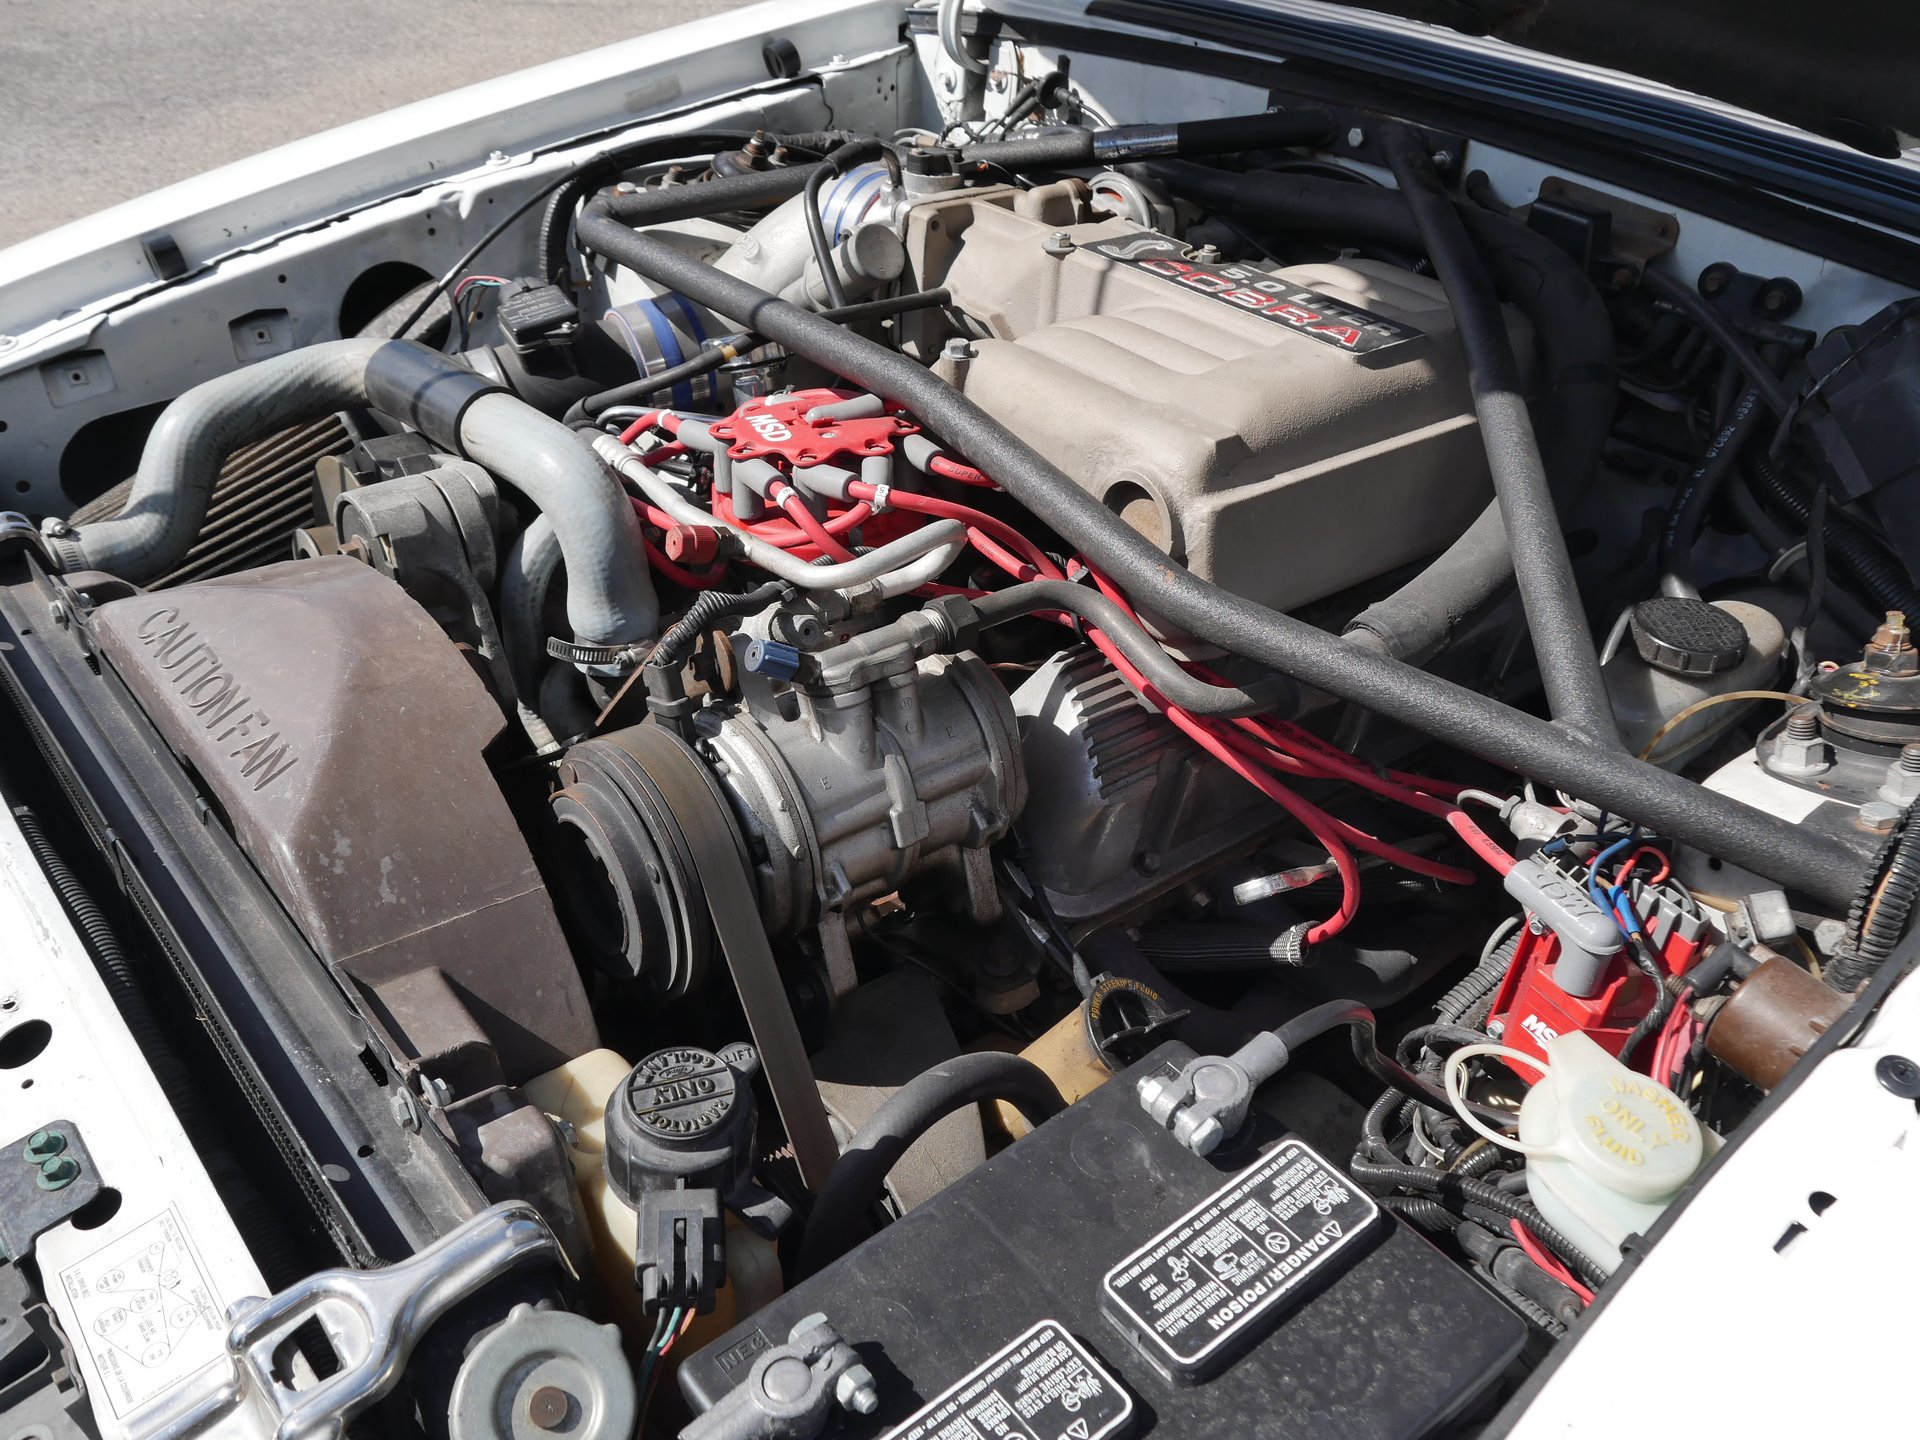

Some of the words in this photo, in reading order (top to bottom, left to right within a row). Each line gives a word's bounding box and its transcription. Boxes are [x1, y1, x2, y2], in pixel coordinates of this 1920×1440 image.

[1138, 257, 1364, 348] COBRA
[1220, 267, 1287, 292] 5.0
[1286, 292, 1401, 338] LITER
[745, 414, 793, 443] MSD
[947, 464, 983, 481] SUPER
[137, 606, 250, 729] CAUTION
[216, 708, 299, 792] FAN
[1091, 993, 1102, 1019] POWER
[1100, 979, 1133, 993] STEERING
[1135, 980, 1159, 1000] FLUID
[1521, 1013, 1560, 1048] MS
[723, 1047, 753, 1065] LIFT
[636, 1050, 716, 1084] COOLANT
[652, 1077, 716, 1106] ONLY
[646, 1099, 730, 1133] RADIATOR
[1610, 1076, 1691, 1143] WASHER
[1601, 1095, 1669, 1150] ONLY
[1585, 1114, 1646, 1167] FLUID
[1274, 1155, 1289, 1166] OUT
[1283, 1146, 1300, 1160] KEEP
[1260, 1166, 1274, 1177] THE
[1268, 1161, 1280, 1171] OF
[1239, 1183, 1251, 1193] OF
[1245, 1172, 1266, 1189] REACH
[1286, 1170, 1307, 1187] CAUSE
[1290, 1169, 1328, 1199] EXPLOSIVE
[1217, 1188, 1244, 1210] CHILDREN
[1294, 1187, 1320, 1208] SHIELD
[1227, 1199, 1256, 1222] SMOKING
[1278, 1204, 1299, 1221] EYES
[1175, 1226, 1193, 1241] KEEP
[1190, 1219, 1204, 1230] TIP
[1255, 1222, 1270, 1235] NO
[1185, 1233, 1209, 1253] INJURY
[1209, 1239, 1231, 1257] CAUSE
[1227, 1231, 1242, 1244] CAN
[1136, 1254, 1156, 1270] TIGHT
[1238, 1249, 1259, 1266] ACID
[1267, 1231, 1330, 1283] DANGER
[1126, 1264, 1143, 1278] AND
[1229, 1256, 1266, 1286] SULFURIC
[1136, 1273, 1158, 1291] FAST
[1146, 1282, 1168, 1301] HELP
[1179, 1278, 1197, 1292] GET
[1191, 1279, 1218, 1302] WATER
[1152, 1287, 1184, 1313] MEDICAL
[1200, 1287, 1227, 1309] FLUSH
[1206, 1280, 1268, 1332] POISON
[1152, 1295, 1198, 1332] IMMEDIATELY
[1183, 1303, 1206, 1323] EYES
[1026, 1337, 1041, 1353] OUT
[1037, 1327, 1055, 1345] KEEP
[721, 1337, 766, 1371] NEG
[1008, 1351, 1023, 1366] THE
[1018, 1346, 1030, 1358] OF
[1035, 1355, 1060, 1377] CAUSE
[1038, 1354, 1082, 1393] EXPLOSIVE
[1040, 1377, 1070, 1405] SHIELD
[964, 1390, 998, 1420] SMOKING
[1021, 1398, 1044, 1419] EYES
[922, 1415, 938, 1430] TIP
[982, 1405, 1011, 1431] SPARKS
[993, 1420, 1010, 1437] NO
